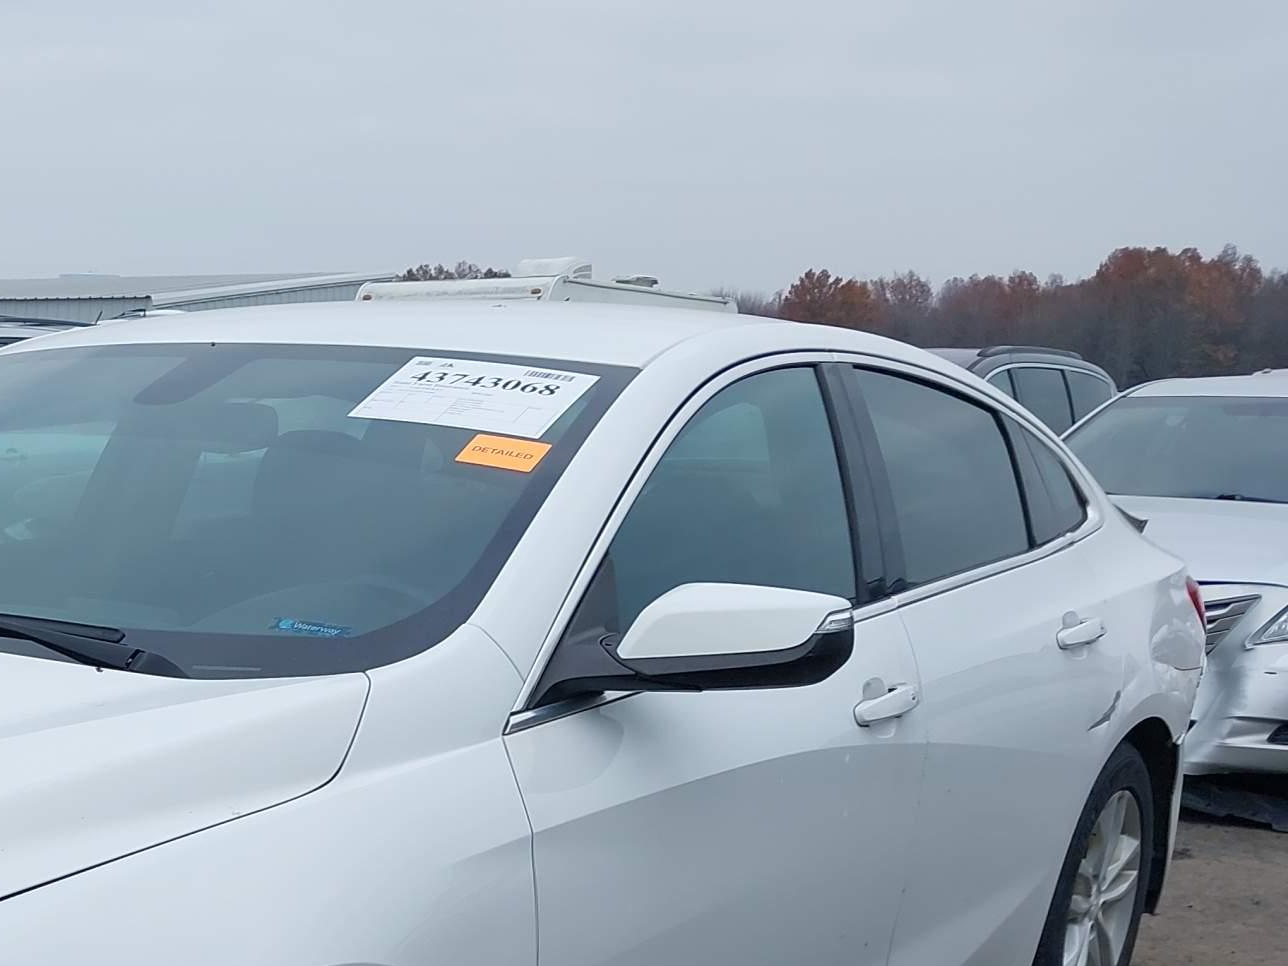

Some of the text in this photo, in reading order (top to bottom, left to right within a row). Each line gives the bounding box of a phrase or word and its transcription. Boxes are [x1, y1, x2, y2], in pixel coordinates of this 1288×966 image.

[410, 371, 560, 396] 43743068
[472, 445, 534, 460] DETAILED
[294, 622, 342, 636] Waterway
